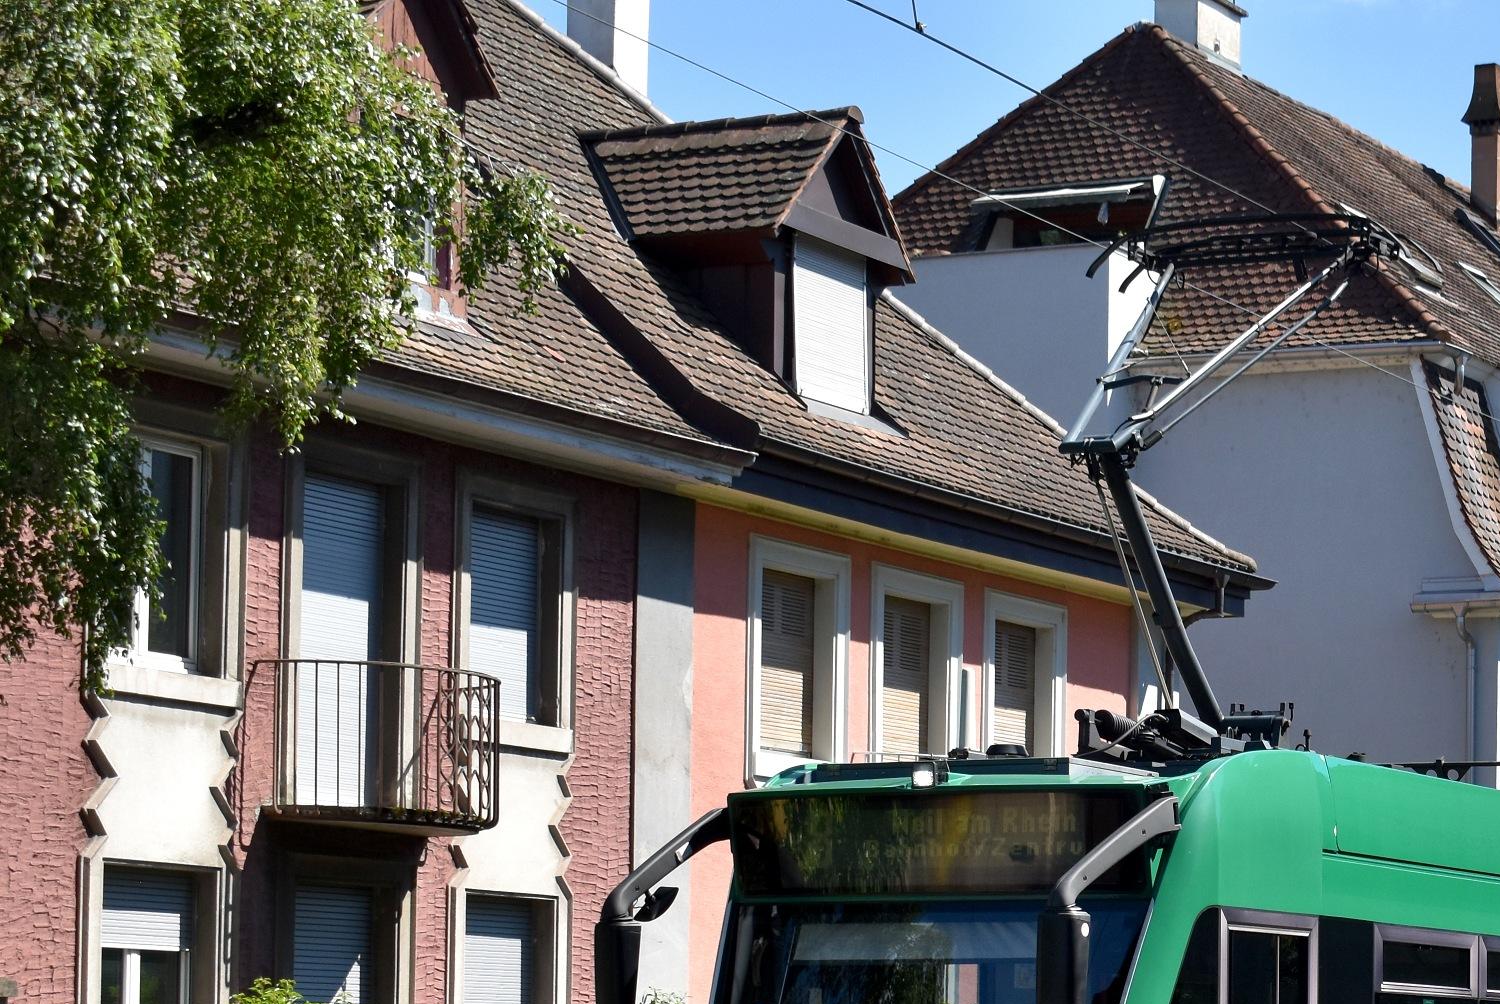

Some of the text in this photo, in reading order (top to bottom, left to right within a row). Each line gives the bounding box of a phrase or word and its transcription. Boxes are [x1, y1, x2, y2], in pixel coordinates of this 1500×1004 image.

[891, 806, 1078, 834] Weil am Rhein
